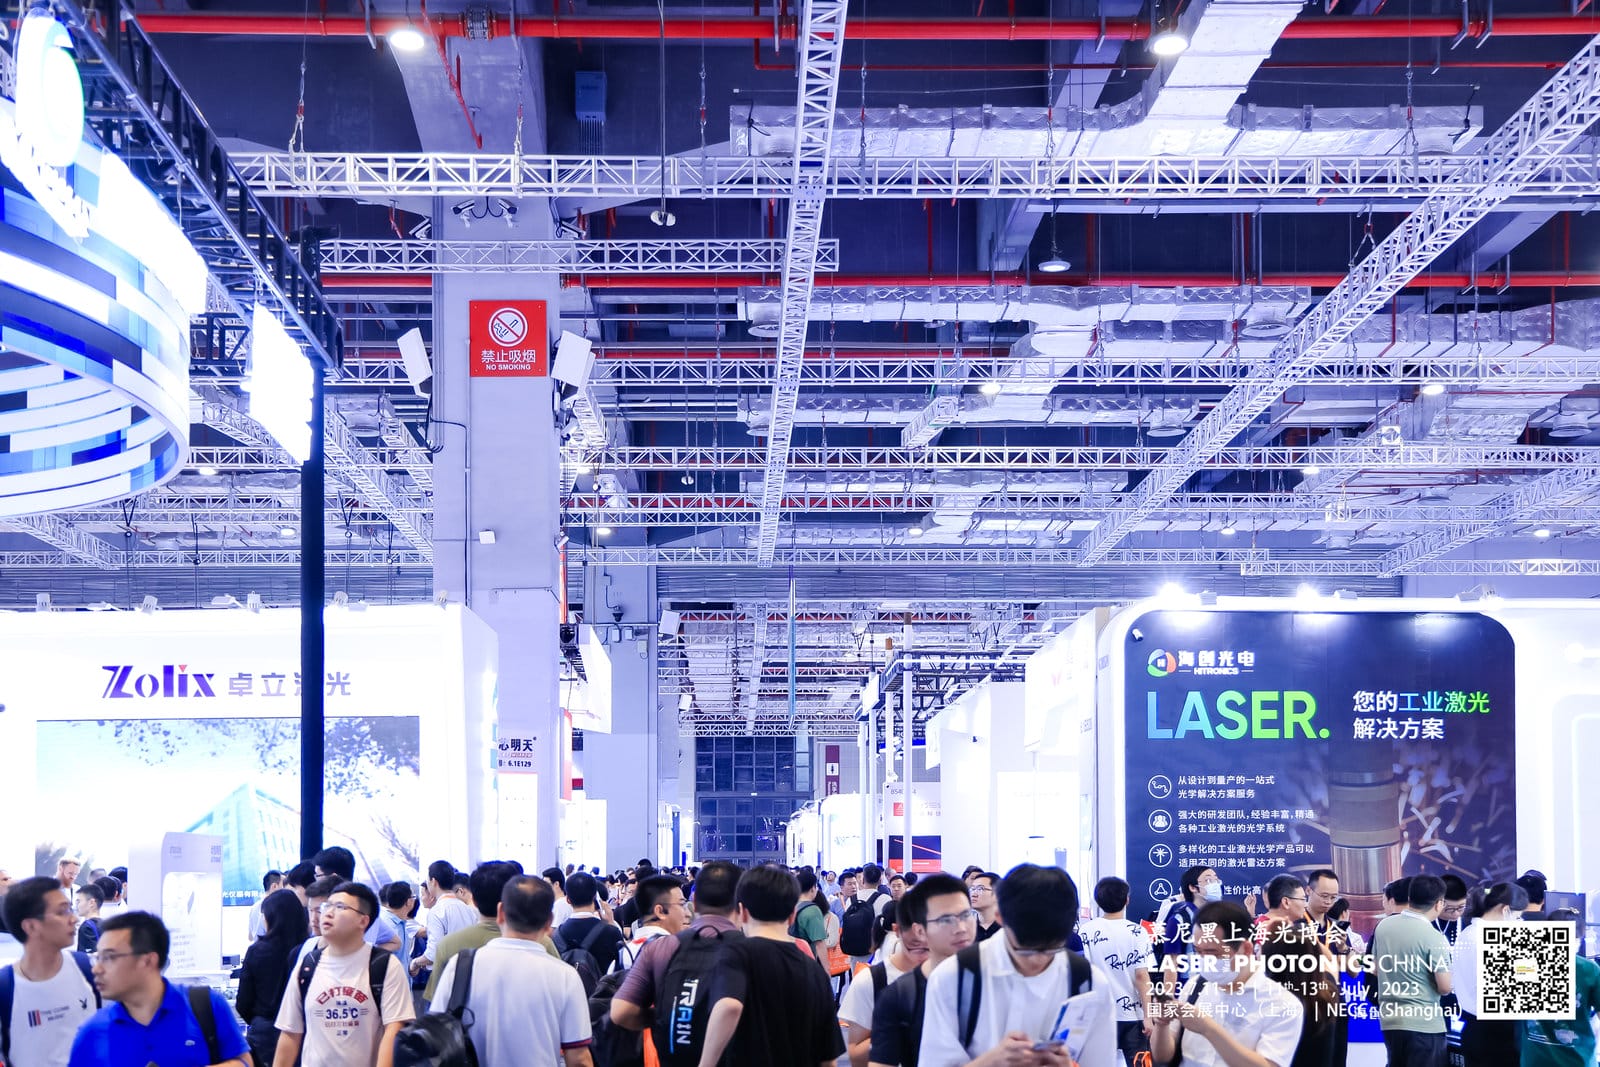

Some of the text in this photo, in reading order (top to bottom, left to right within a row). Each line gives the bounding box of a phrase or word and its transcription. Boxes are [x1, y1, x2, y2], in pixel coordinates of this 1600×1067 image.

[481, 349, 536, 363] 禁止吸烟
[1178, 650, 1255, 667] 海创光电
[1193, 667, 1239, 675] HITRONICS
[102, 665, 216, 698] Zolix
[1353, 690, 1490, 713] 您的工业激光
[1147, 690, 1331, 740] LASER.
[1353, 717, 1444, 740] 解决方案
[1178, 775, 1275, 785] 从设计到量产的一站式
[1178, 789, 1256, 799] 光学解决方案服务
[1178, 823, 1286, 834] 各种工业激光的光学系统
[1178, 843, 1315, 854] 多样化的工业激光光学产品可以
[1178, 857, 1286, 868] 适用不同的激光雷达方案
[316, 986, 369, 1005] 已打疫苗
